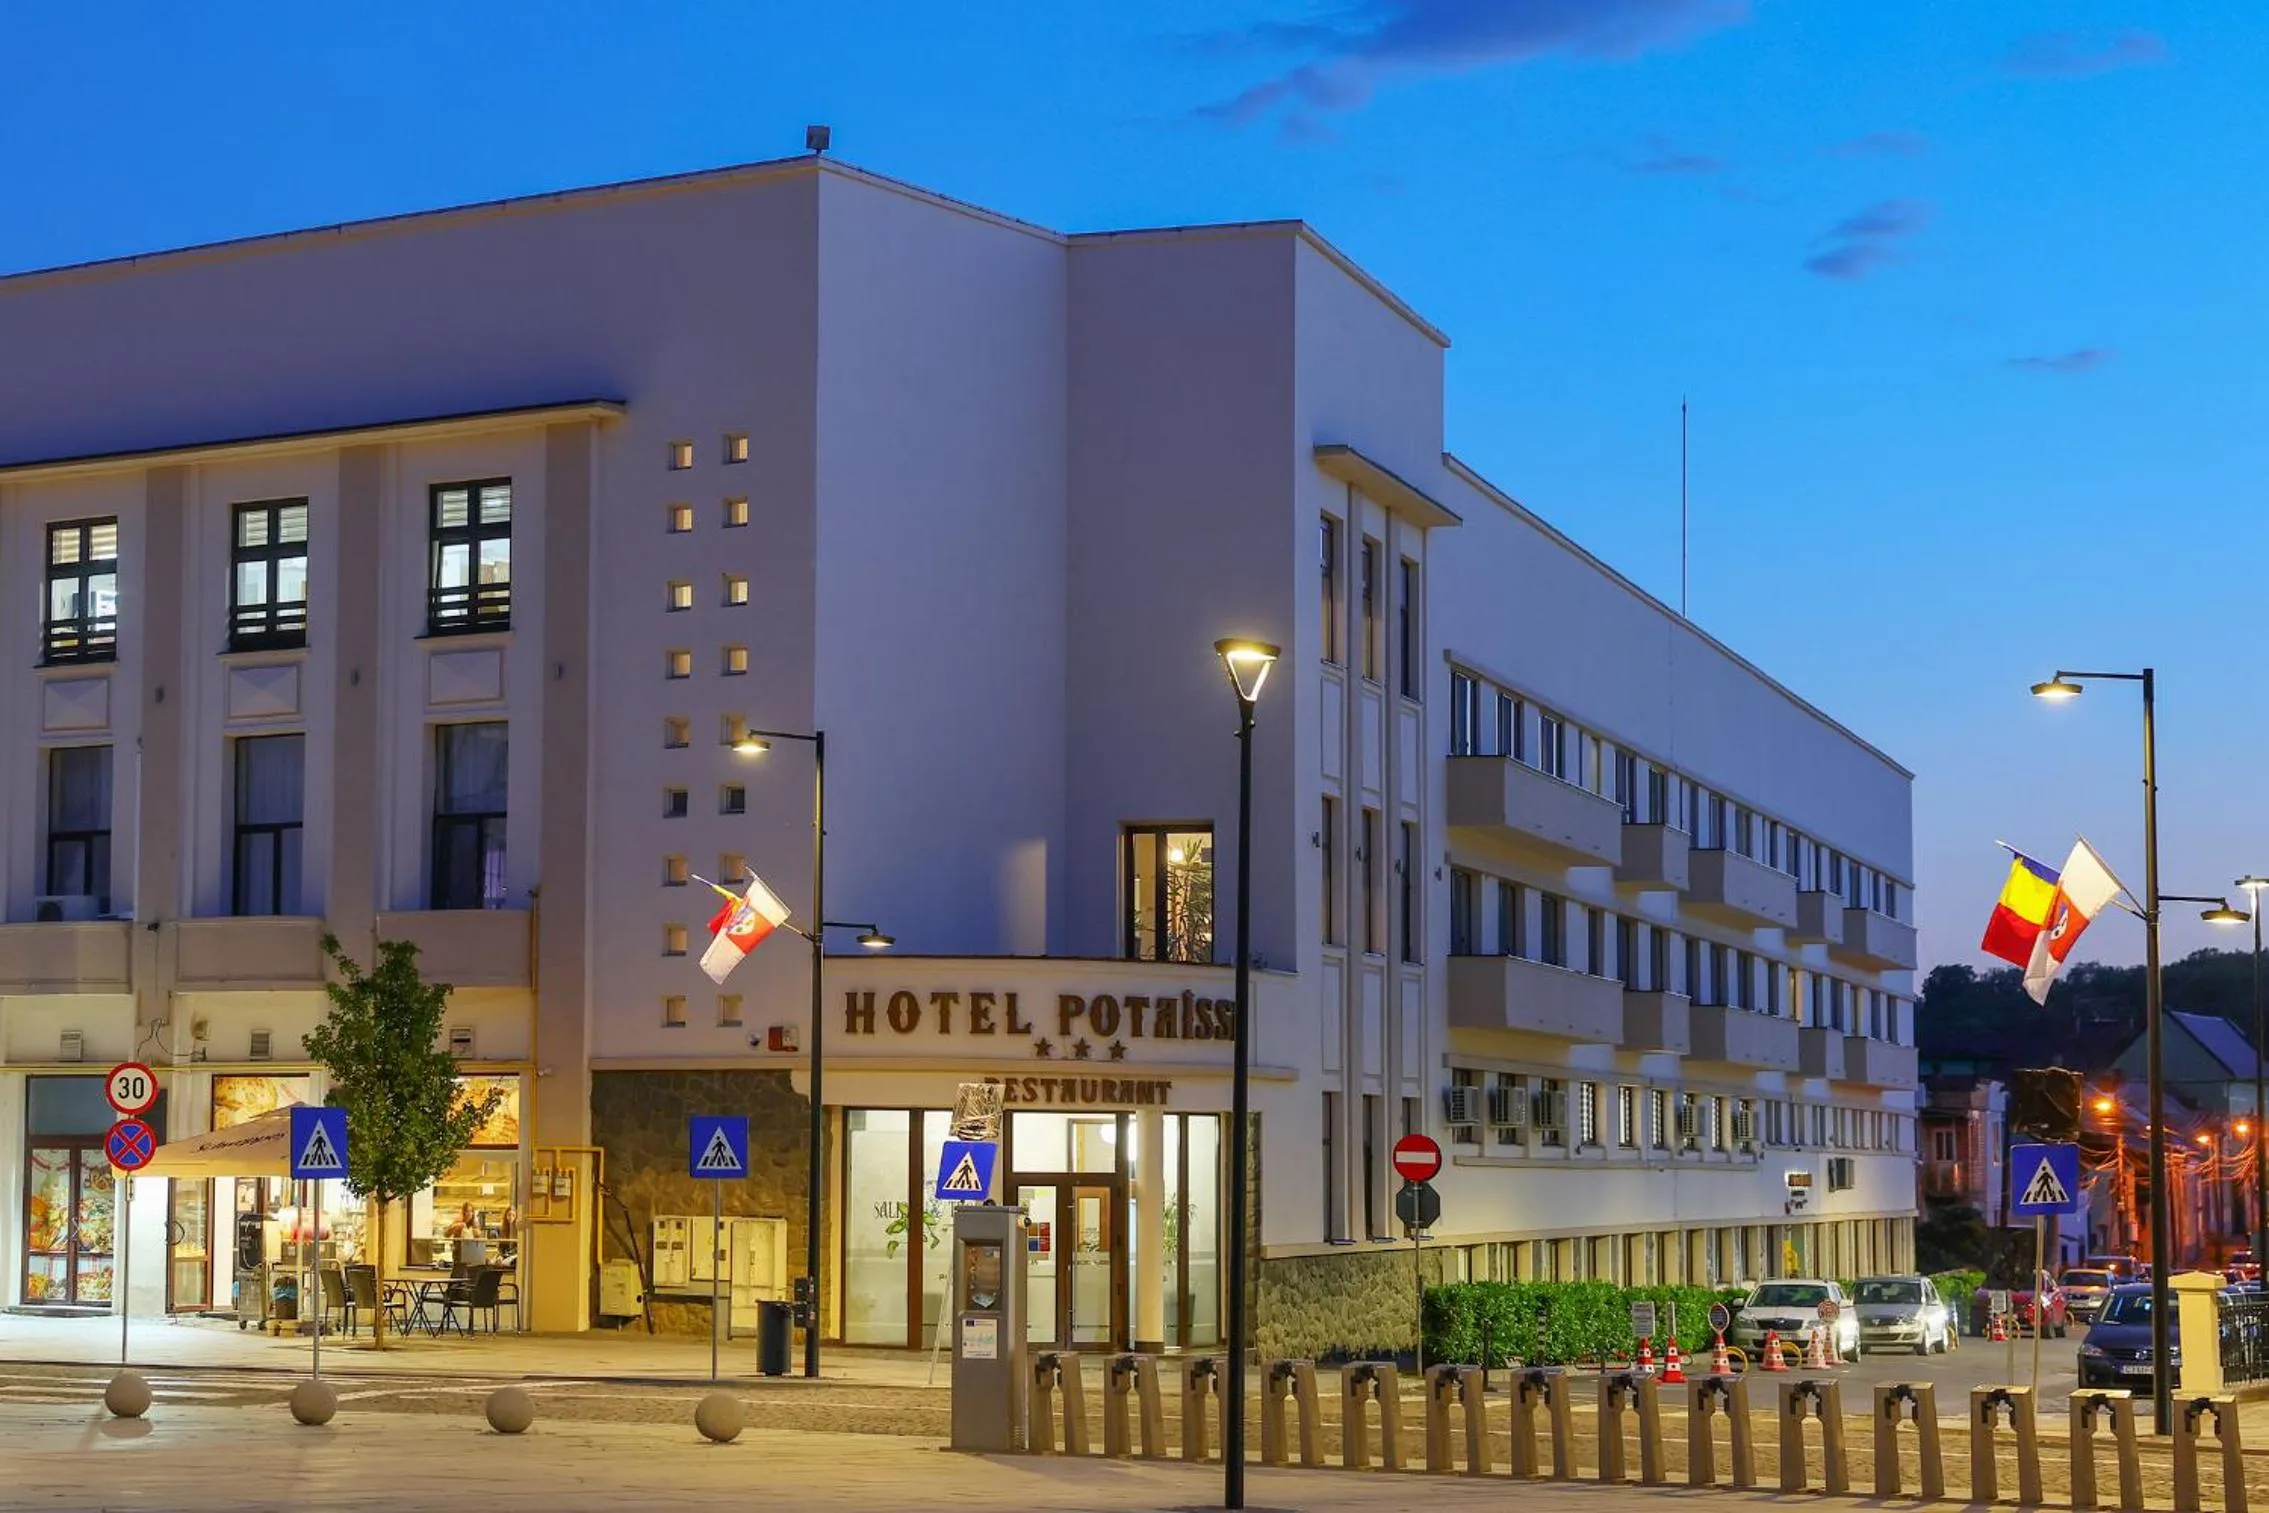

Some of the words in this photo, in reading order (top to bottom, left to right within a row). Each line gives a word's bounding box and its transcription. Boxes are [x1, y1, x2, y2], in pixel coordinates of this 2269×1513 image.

[845, 990, 1032, 1034] HOTEL
[1058, 989, 1236, 1041] POTAISS
[119, 1076, 144, 1099] 30
